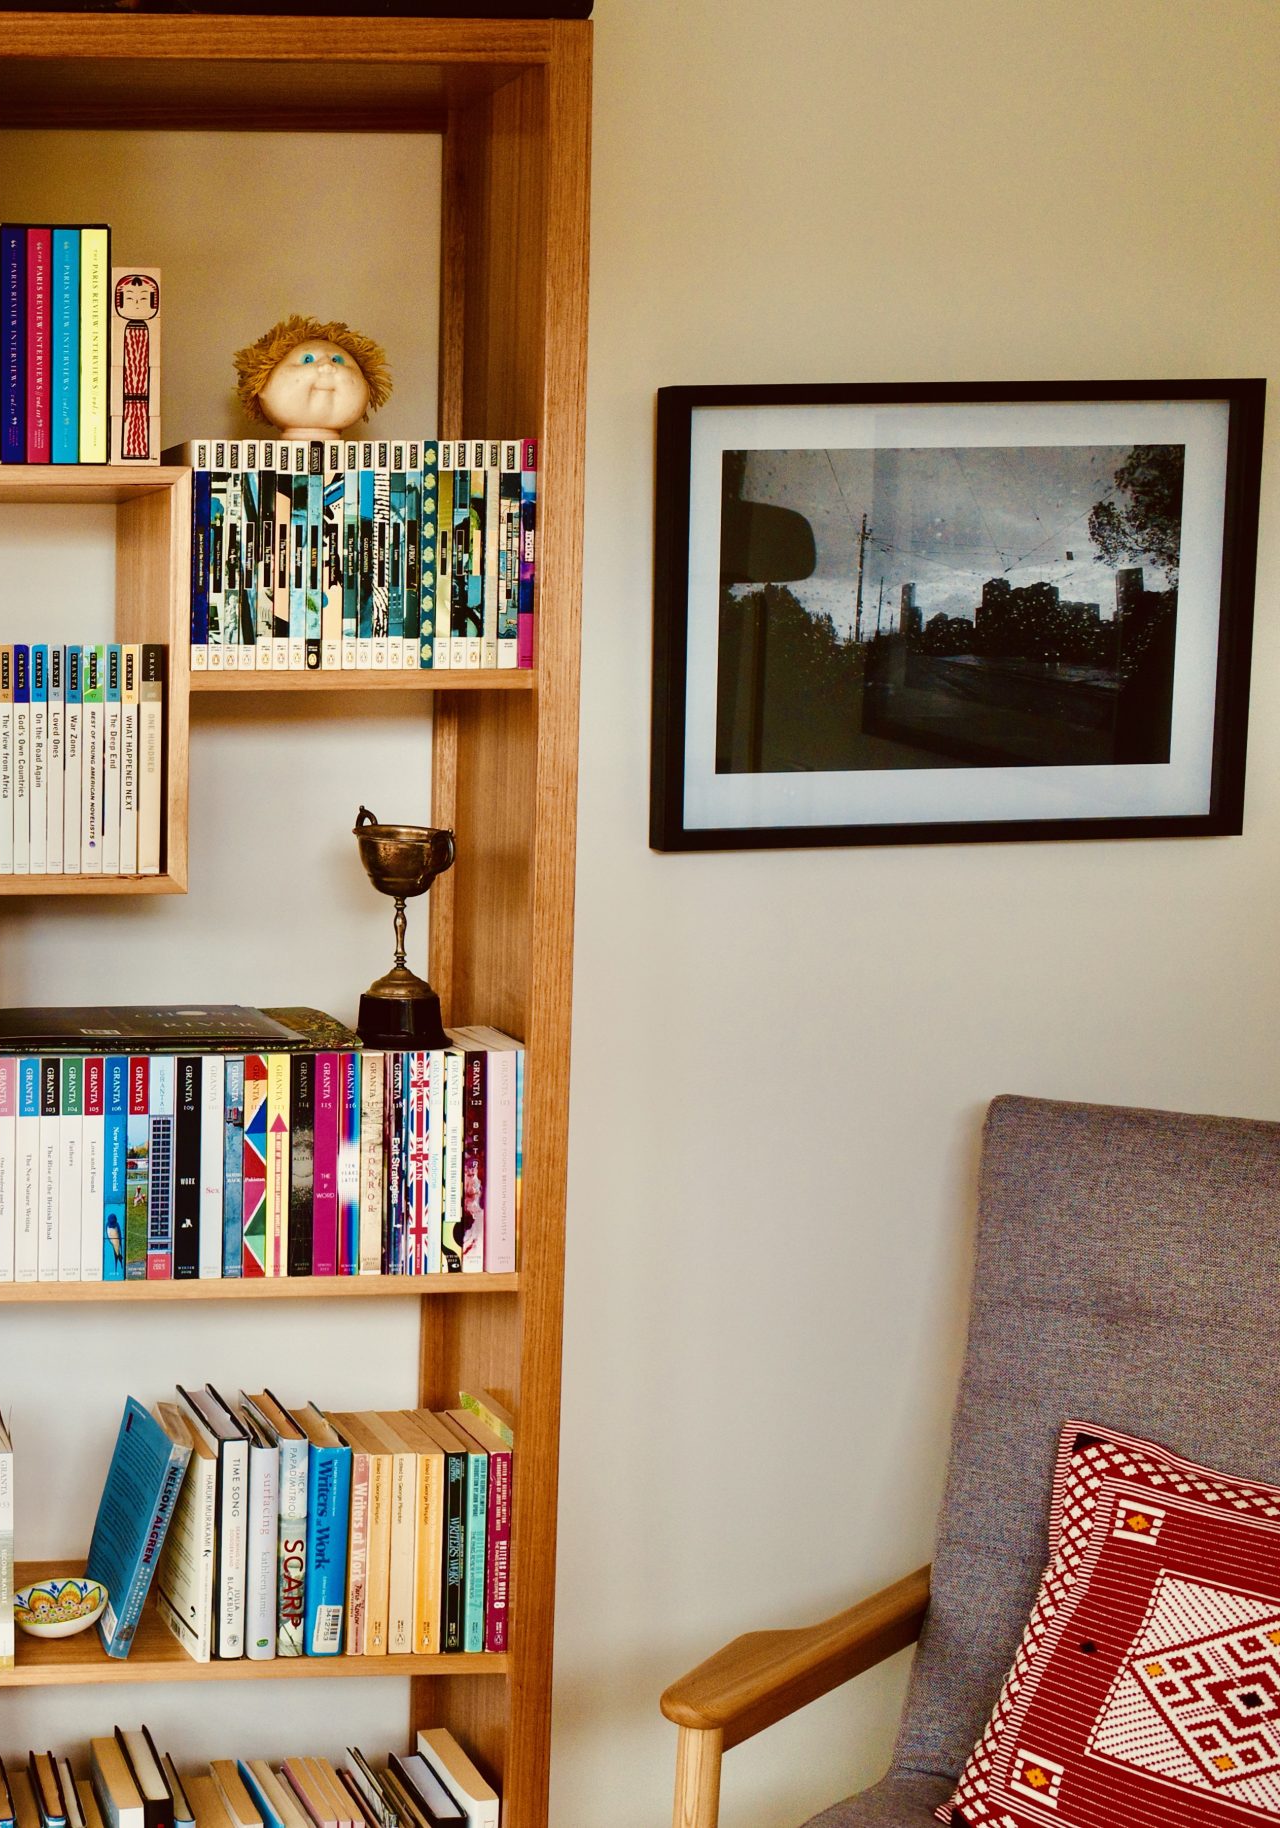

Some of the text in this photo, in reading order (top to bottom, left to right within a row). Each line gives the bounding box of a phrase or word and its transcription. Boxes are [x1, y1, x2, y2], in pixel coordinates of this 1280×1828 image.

[524, 530, 534, 562] India!
[135, 1066, 143, 1103] GRANTA
[111, 1127, 120, 1192] New Fiction Special
[390, 1137, 400, 1204] Exit Strategies
[142, 1466, 180, 1564] NELSON ALGREN
[230, 1459, 241, 1517] TIME SONG
[316, 1460, 333, 1517] Writers
[314, 1526, 332, 1570] Work
[226, 1576, 234, 1624] BLACKBURN
[281, 1540, 304, 1629] SCARP
